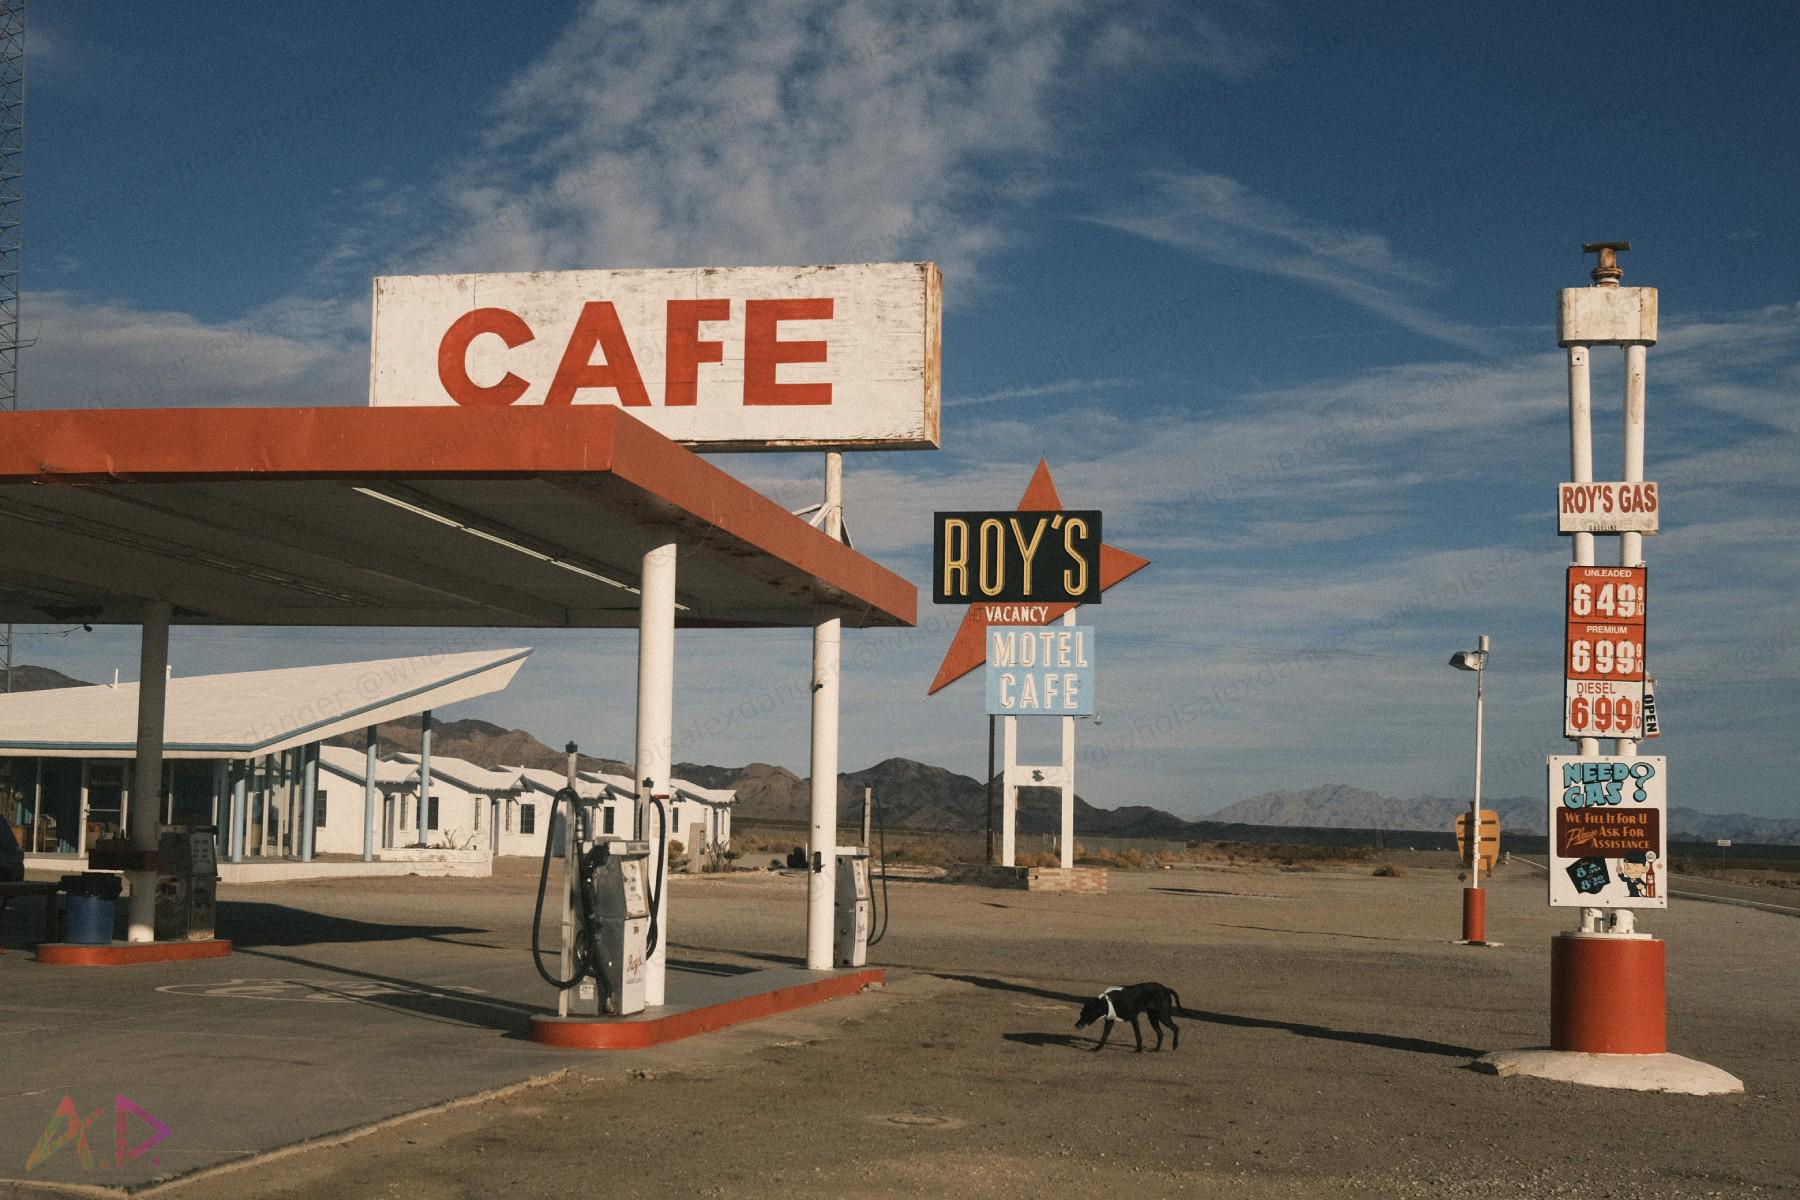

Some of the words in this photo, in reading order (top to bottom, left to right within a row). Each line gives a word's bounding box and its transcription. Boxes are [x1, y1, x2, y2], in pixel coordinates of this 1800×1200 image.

[437, 297, 834, 406] CAFE
[1562, 485, 1614, 514] ROY'S
[1619, 484, 1657, 513] GAS
[943, 513, 1089, 597] ROY'S
[1584, 569, 1632, 578] UNLEADED
[985, 605, 1048, 622] VACANCY
[1573, 583, 1636, 617] 649
[1586, 625, 1628, 634] PREMIUM
[992, 631, 1088, 667] MOTEL
[1571, 639, 1635, 674] 699
[999, 672, 1079, 709] CAFE
[1576, 682, 1616, 694] DIESEL
[1571, 696, 1633, 731] 699
[1644, 694, 1658, 733] OPEN
[1638, 813, 1647, 824] U
[1591, 837, 1649, 849] ASSISTANCE
